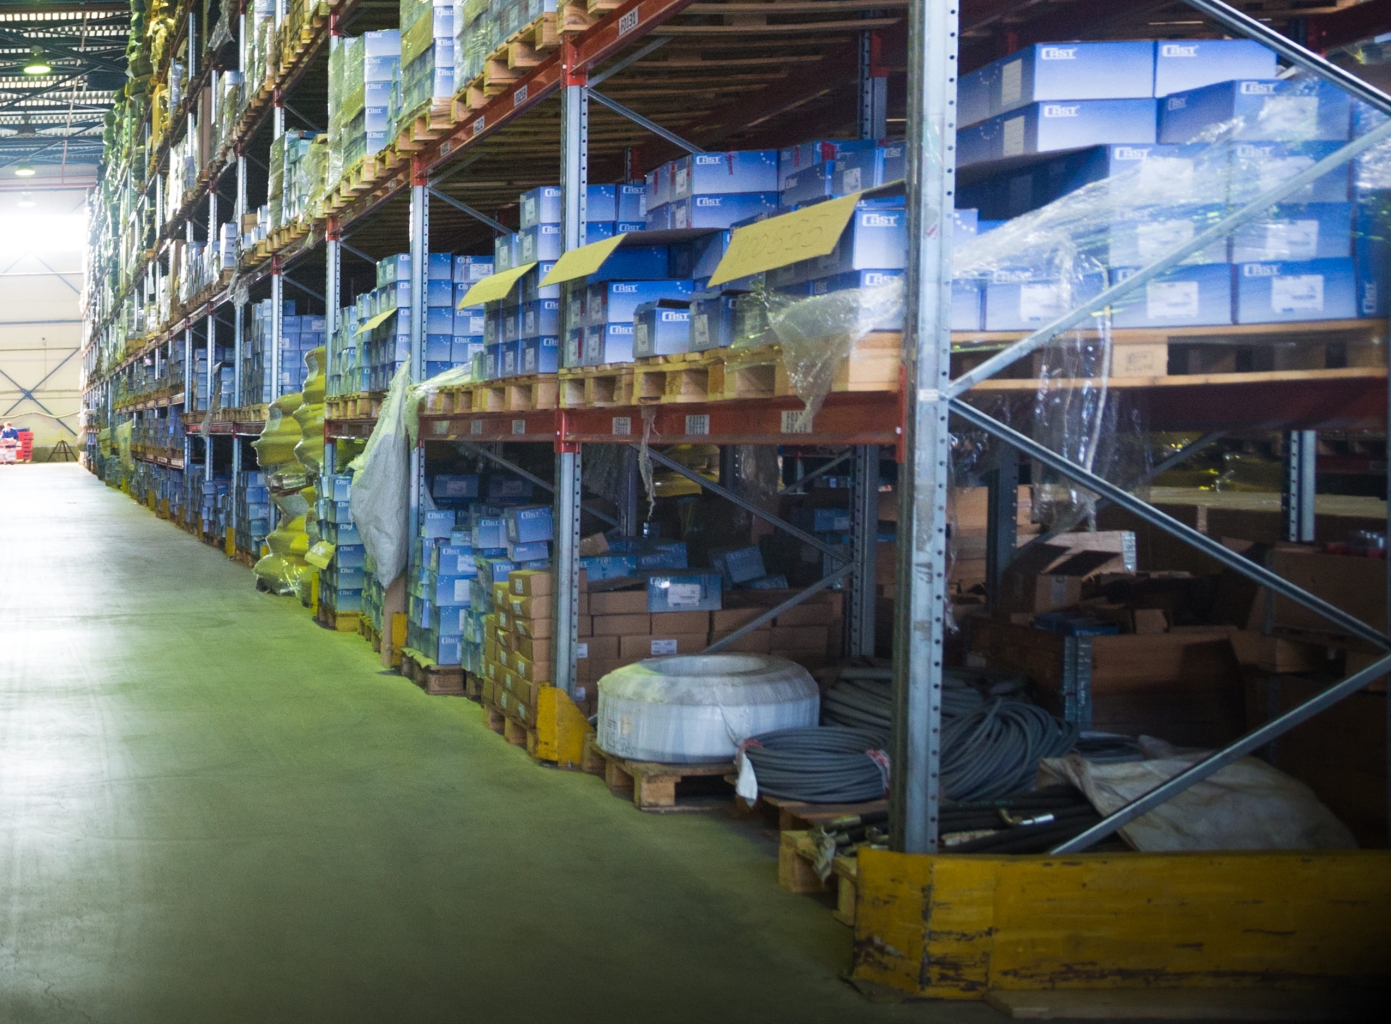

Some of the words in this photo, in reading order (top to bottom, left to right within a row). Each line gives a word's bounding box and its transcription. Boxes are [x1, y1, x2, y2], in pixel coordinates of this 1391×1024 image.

[1041, 47, 1077, 60] CAST
[1162, 44, 1198, 57] CAST
[1240, 81, 1276, 94] CAST
[1043, 105, 1079, 118] CAST
[696, 156, 722, 164] CAST
[1114, 147, 1149, 160] CAST
[623, 186, 645, 194] CAST
[697, 198, 722, 206] CAST
[861, 214, 897, 227] CAST
[619, 223, 641, 232] CAST
[1243, 264, 1281, 277] CAST
[865, 273, 893, 286] CAS
[613, 284, 637, 292] CAST
[662, 312, 690, 321] CAST
